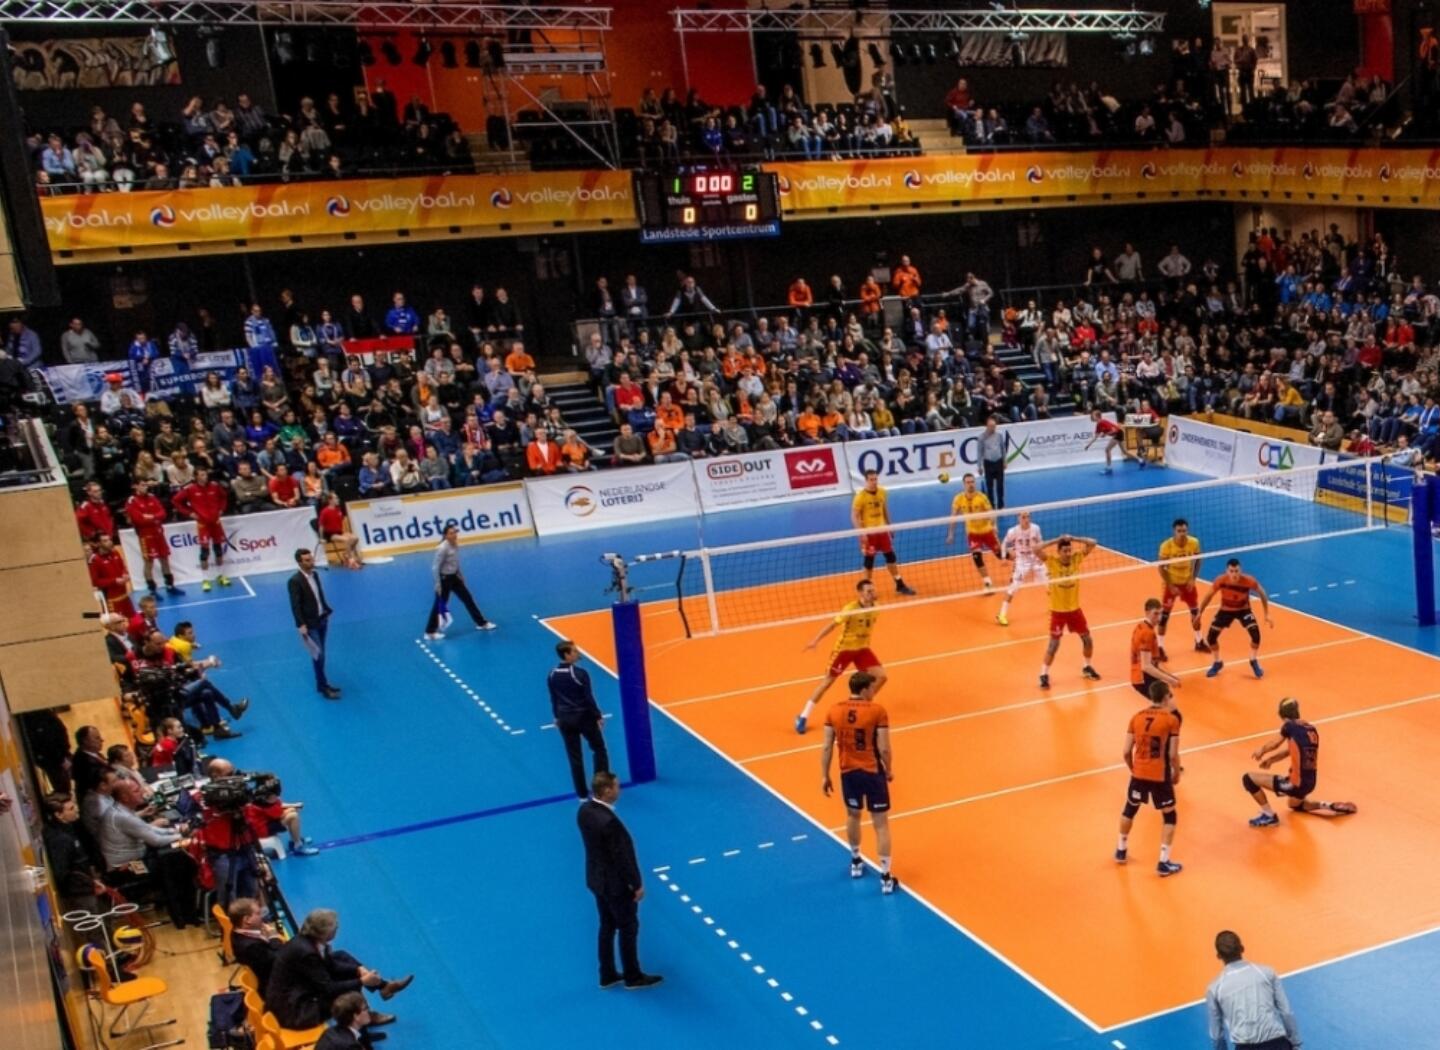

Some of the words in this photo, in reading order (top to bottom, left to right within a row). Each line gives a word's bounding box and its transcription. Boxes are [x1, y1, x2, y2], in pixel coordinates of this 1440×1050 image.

[925, 168, 1015, 187] volleybal.nl
[1048, 164, 1130, 182] volleybal.nl
[743, 175, 753, 190] 2
[795, 174, 891, 192] volleybal.nl
[355, 194, 475, 213] volleybal.nl
[515, 186, 628, 205] volleybal.nl
[180, 201, 309, 222] volleybal.nl
[684, 207, 695, 223] 0
[746, 204, 757, 220] 0
[46, 210, 133, 233] eybal.nl
[643, 227, 699, 240] Landstede
[703, 223, 776, 239] Sportcentrum
[362, 503, 522, 545] landstede.nl
[239, 535, 278, 552] Sport
[848, 709, 857, 724] 5
[1144, 716, 1155, 732] 7
